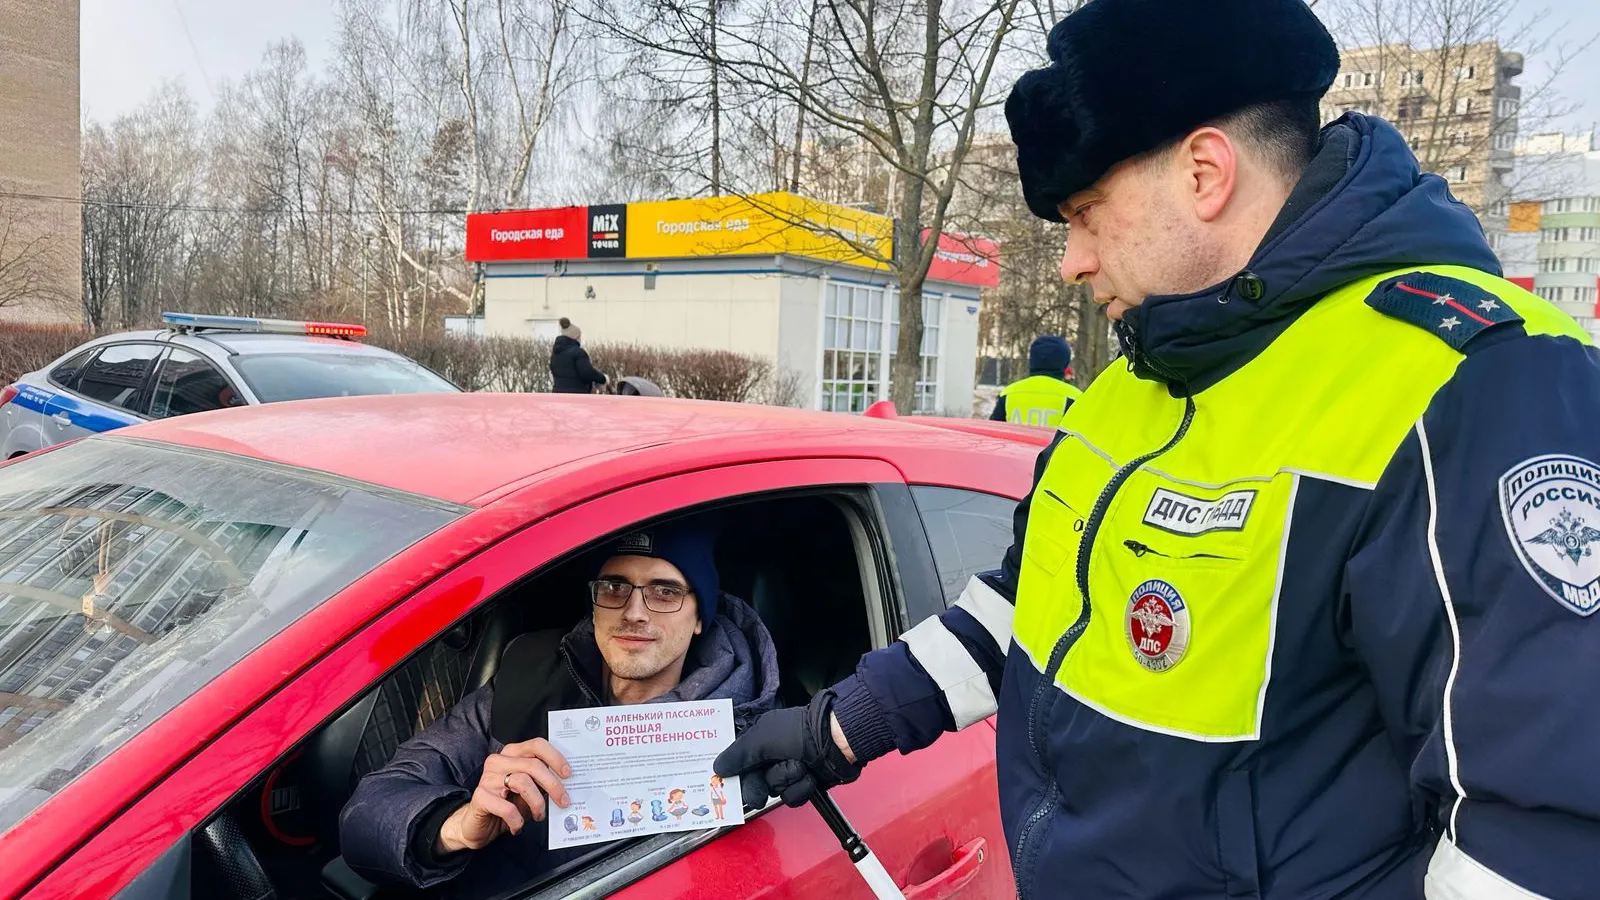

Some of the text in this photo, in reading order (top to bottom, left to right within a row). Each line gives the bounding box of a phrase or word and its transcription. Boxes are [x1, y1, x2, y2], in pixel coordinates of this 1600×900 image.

[592, 214, 619, 232] MiX
[656, 218, 749, 235] Городская еда
[490, 227, 564, 243] Городская еда
[1152, 499, 1200, 525] ДПС
[1133, 581, 1182, 610] ПОЛИЦИЯ
[1139, 637, 1161, 653] ДПС
[605, 711, 663, 723] МАЛЕНЬКИЙ
[665, 708, 715, 719] ПАССАЖИР
[605, 723, 661, 736] БОЛЬШАЯ
[606, 729, 718, 747] ОТВЕТСТВЕННОСТЬ!
